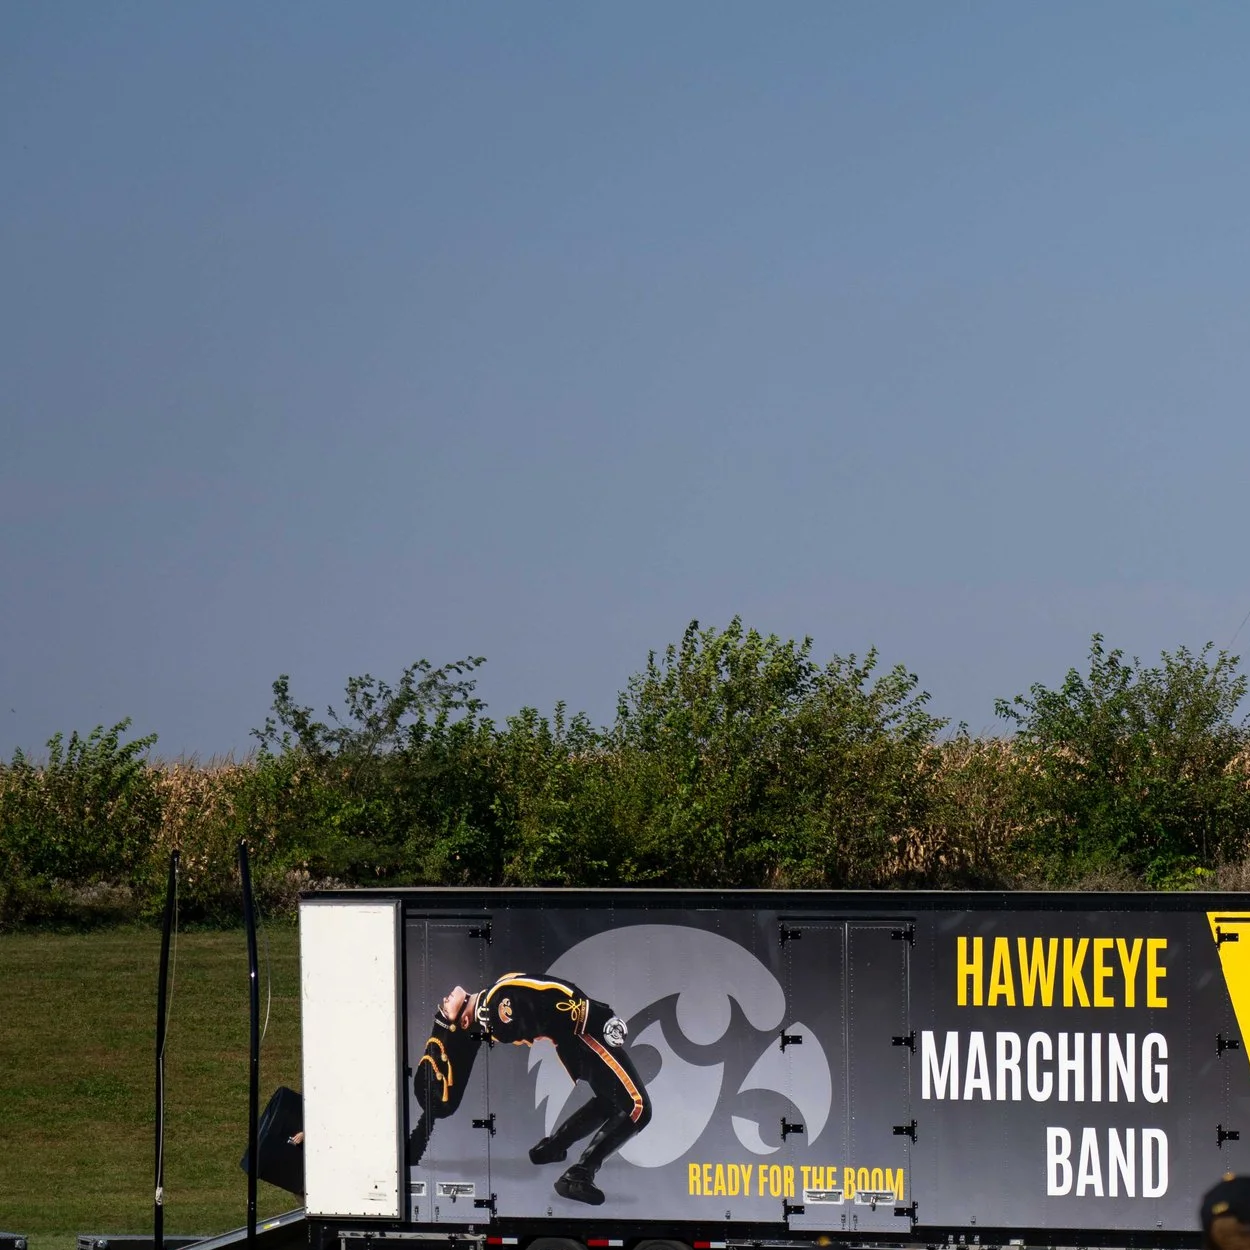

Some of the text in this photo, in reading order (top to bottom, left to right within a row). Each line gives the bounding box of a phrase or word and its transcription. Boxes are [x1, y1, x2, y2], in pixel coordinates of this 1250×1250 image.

[957, 936, 1168, 1008] HAWKEYE
[921, 1031, 1168, 1103] MARCHING
[688, 1163, 904, 1201] READY FOR THE BOOM
[1046, 1126, 1169, 1198] BAND
